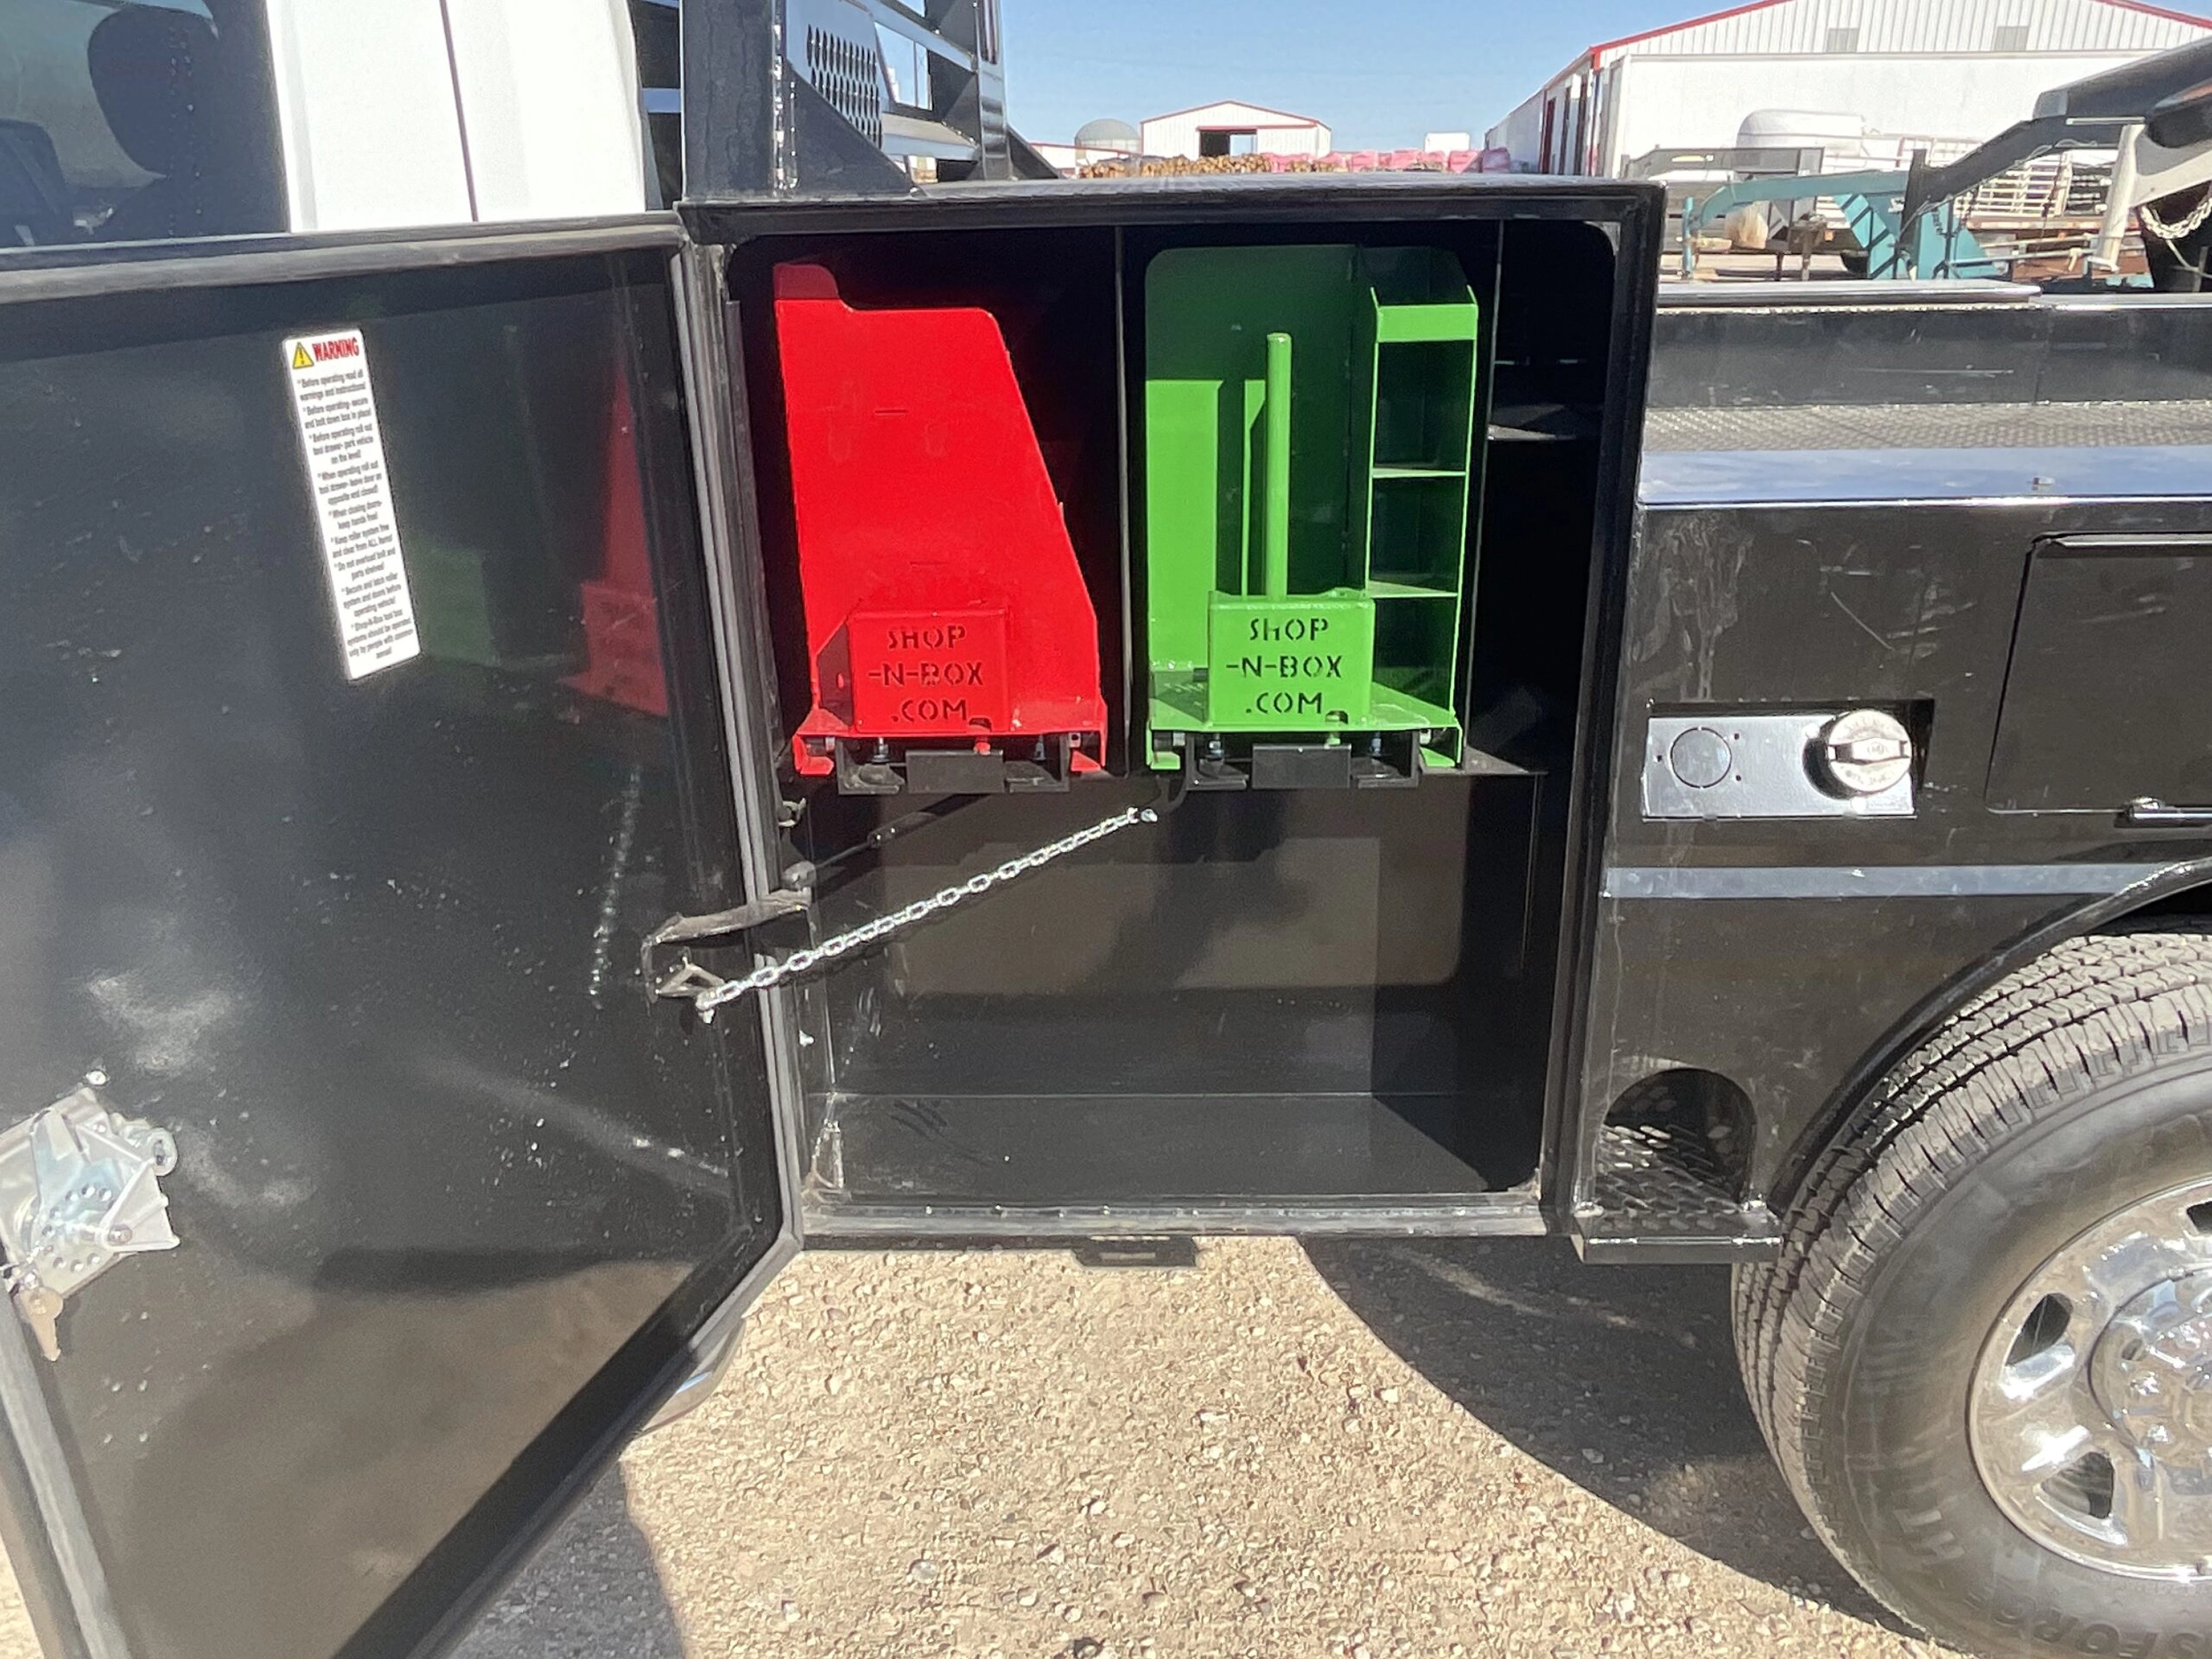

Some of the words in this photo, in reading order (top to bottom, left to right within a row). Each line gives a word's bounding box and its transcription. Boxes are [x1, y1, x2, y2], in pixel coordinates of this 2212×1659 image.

[312, 337, 359, 362] WARNING
[887, 625, 966, 649] SHOP
[1249, 618, 1329, 641] SHOP
[868, 662, 983, 687] -N-BOX
[1225, 655, 1342, 679] -N-BOX
[891, 699, 967, 722] .COM
[1245, 692, 1322, 714] .COM
